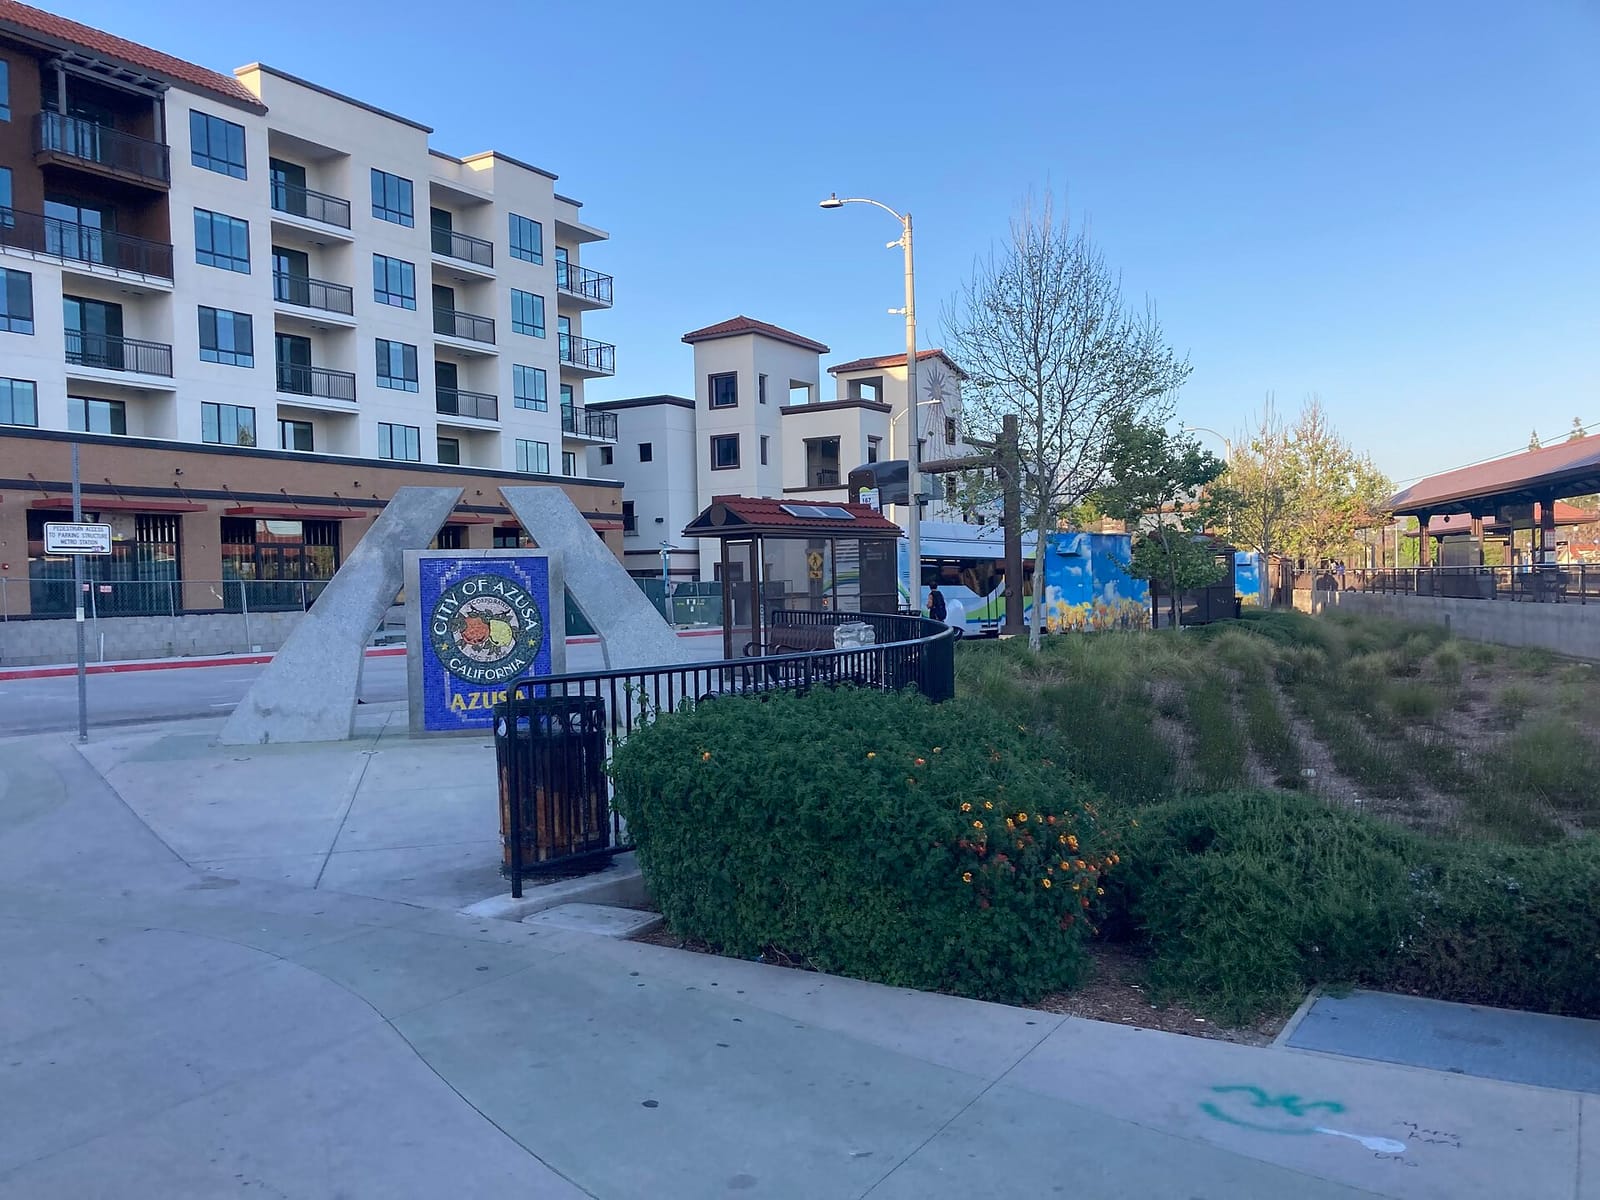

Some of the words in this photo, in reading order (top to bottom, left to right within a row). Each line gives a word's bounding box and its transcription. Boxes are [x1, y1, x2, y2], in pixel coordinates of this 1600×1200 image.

[433, 593, 459, 635] CITY
[462, 579, 488, 595] OF
[493, 581, 537, 631] AZUSA
[449, 658, 526, 680] CALIFORNIA
